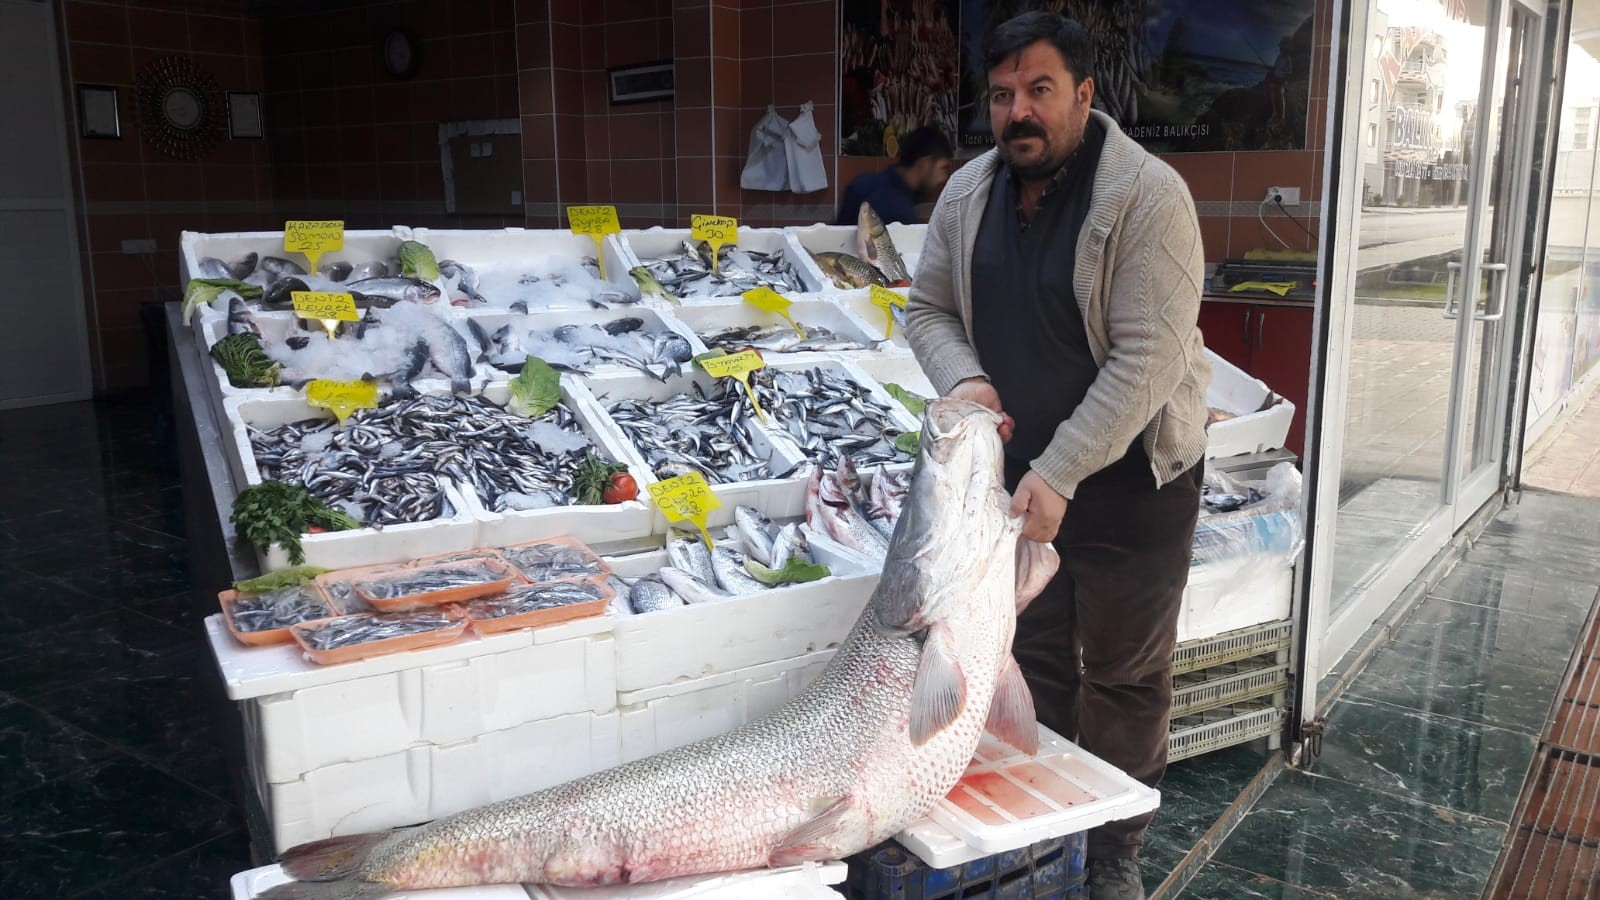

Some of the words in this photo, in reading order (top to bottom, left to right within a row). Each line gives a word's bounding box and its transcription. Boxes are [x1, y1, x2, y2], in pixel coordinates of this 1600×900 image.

[1163, 123, 1209, 140] BALIKÇISI
[705, 229, 724, 239] 30
[297, 241, 325, 251] 25
